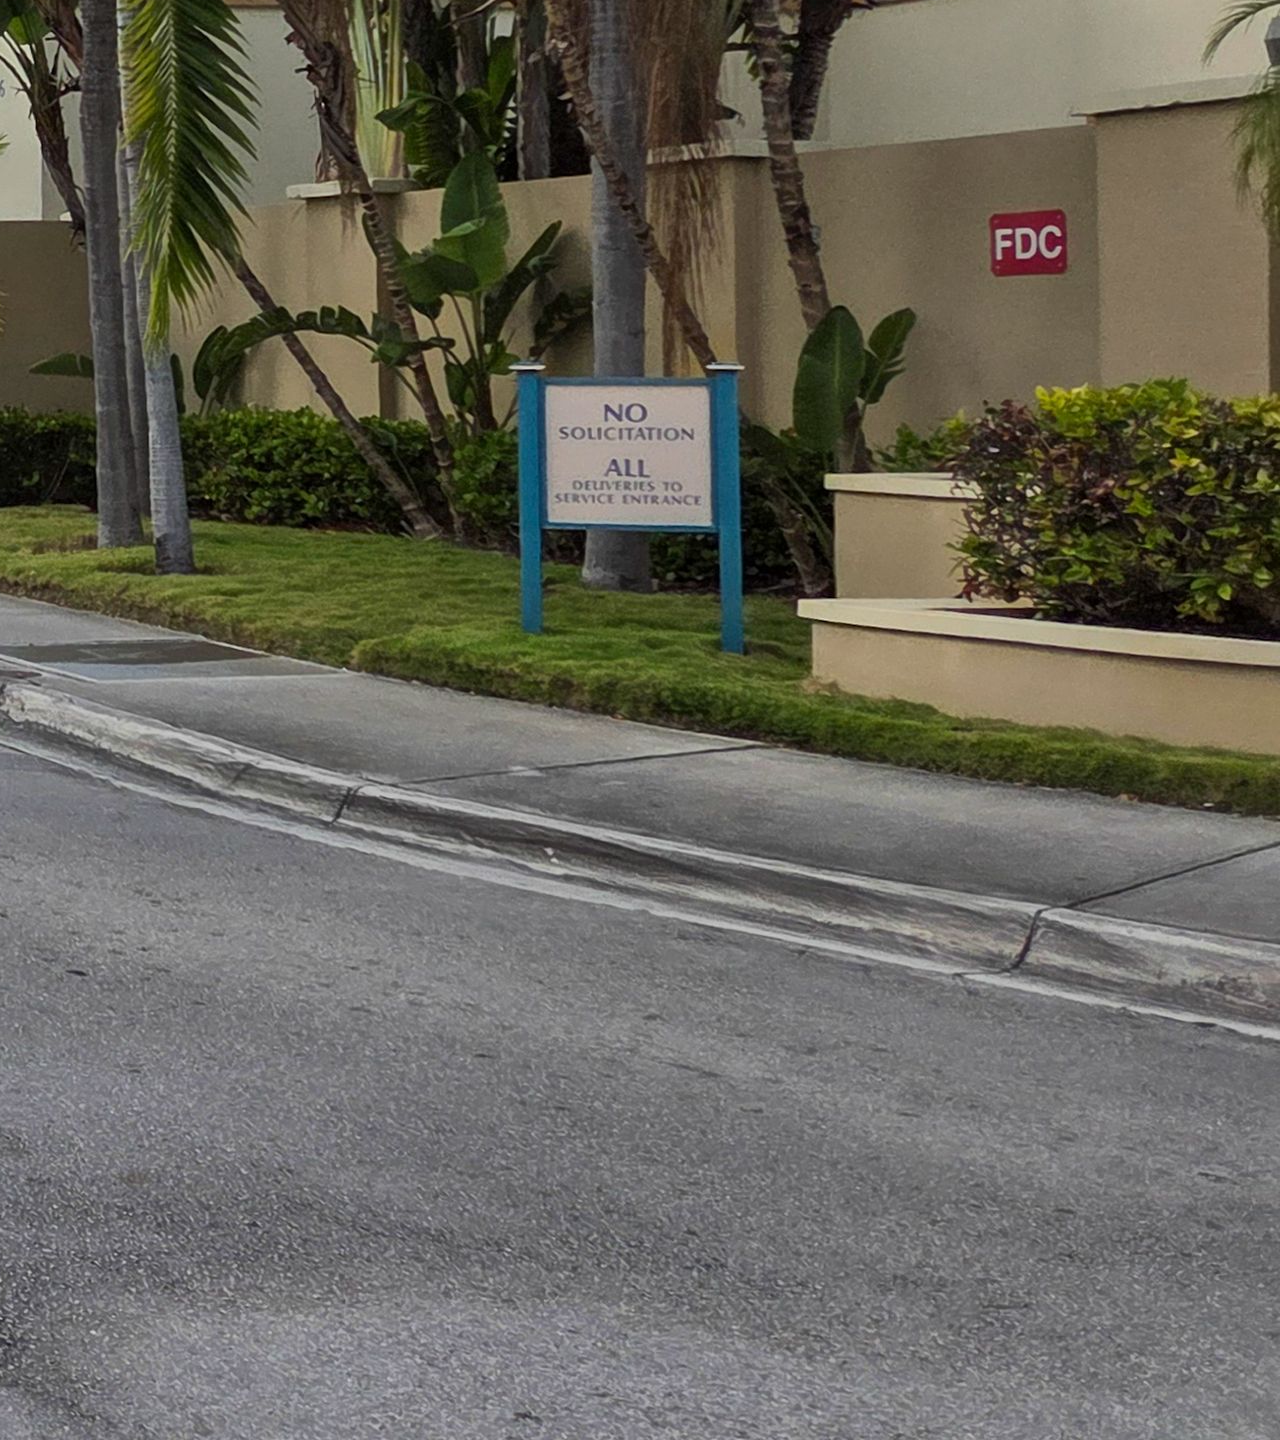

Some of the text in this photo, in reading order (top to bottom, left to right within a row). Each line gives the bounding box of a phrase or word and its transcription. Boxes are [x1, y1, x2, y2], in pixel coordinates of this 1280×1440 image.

[994, 224, 1063, 261] FDC
[603, 403, 648, 423] NO
[558, 426, 695, 441] SOLICITATION
[604, 458, 651, 478] ALL
[572, 480, 683, 493] DELIVERIES TO
[554, 493, 702, 506] SERVICE ENTRANCE
